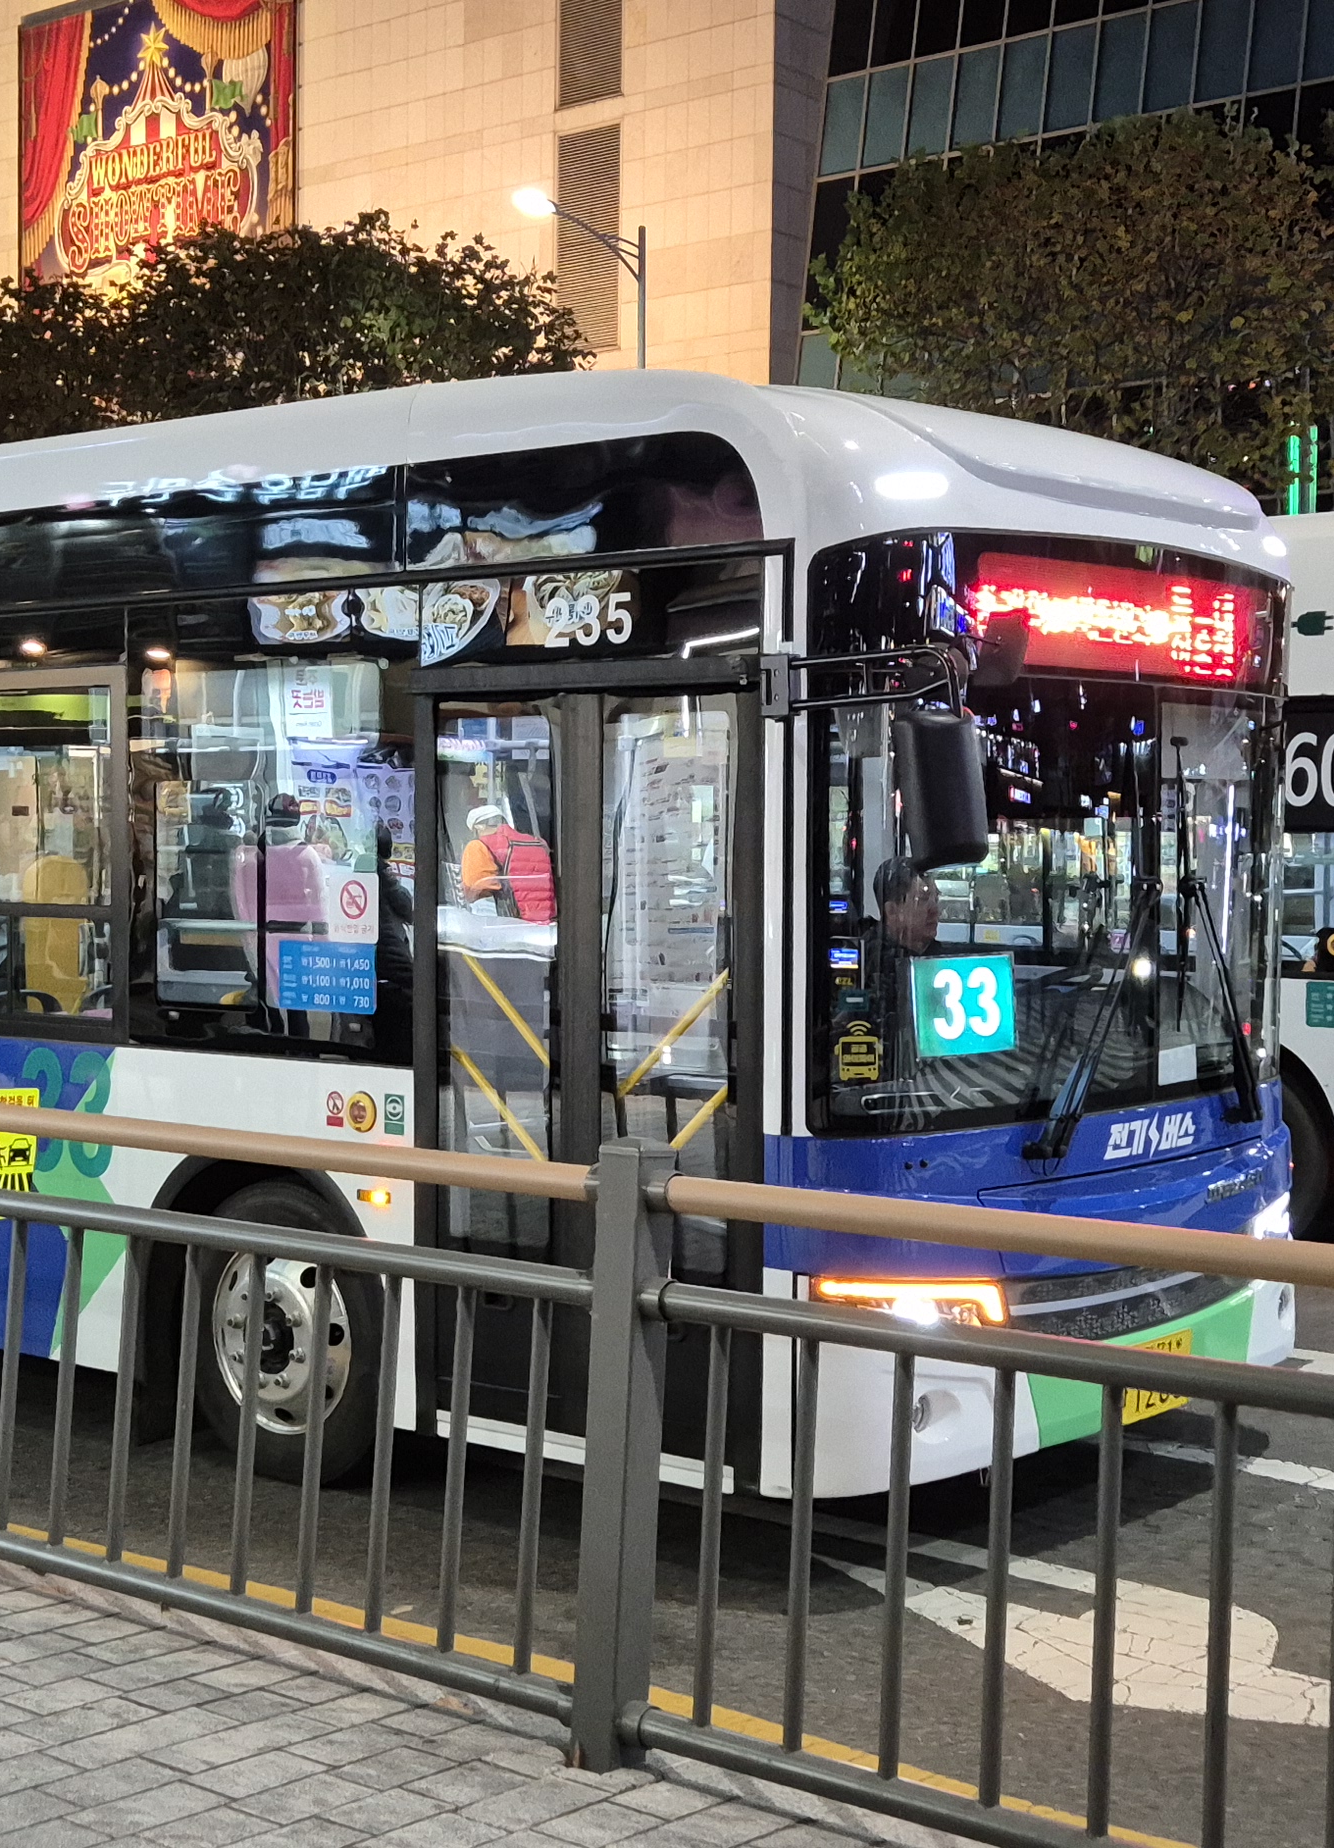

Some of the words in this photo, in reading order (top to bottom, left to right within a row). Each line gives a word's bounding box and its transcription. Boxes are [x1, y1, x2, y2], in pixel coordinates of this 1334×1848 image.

[89, 128, 217, 193] WONDERFUL
[67, 166, 241, 274] SHOWTIME
[544, 591, 633, 649] 235
[353, 996, 370, 1008] 730
[933, 967, 1002, 1040] 33
[1103, 1111, 1196, 1160] 전기버스
